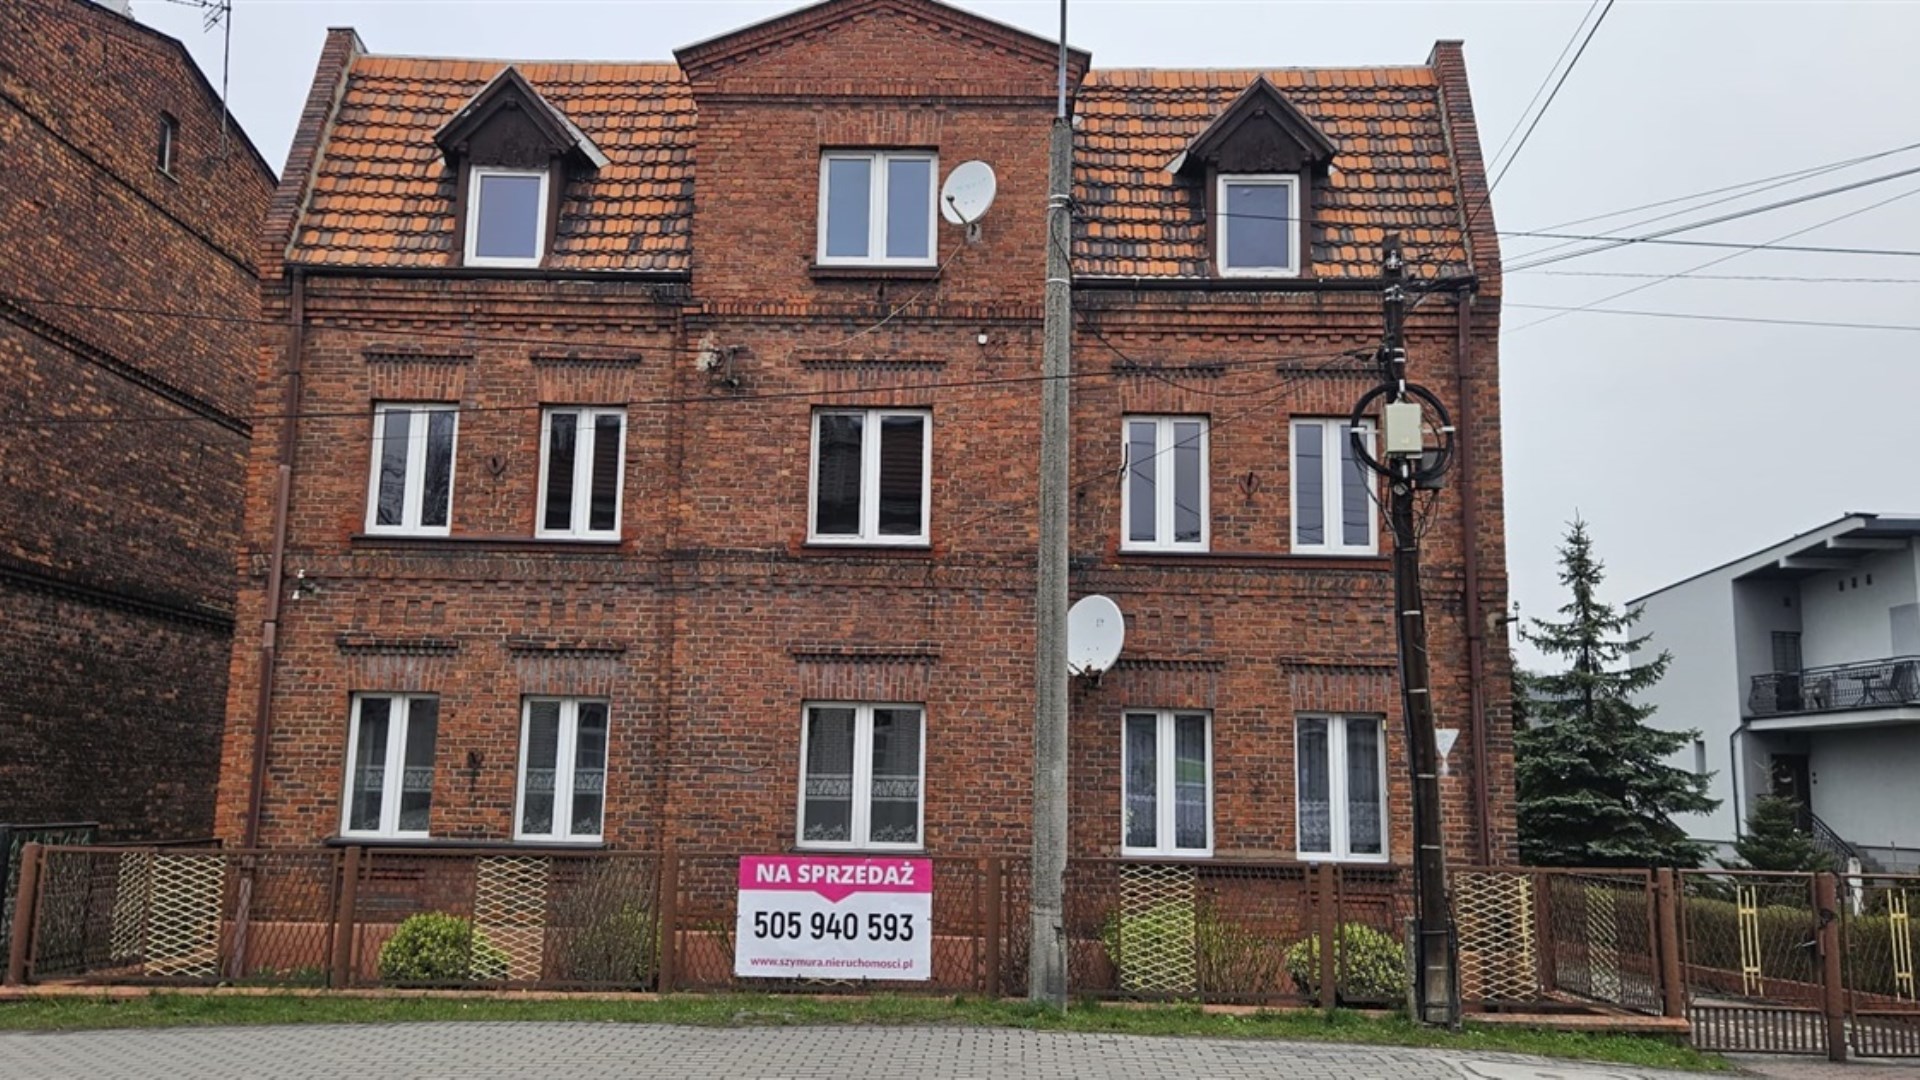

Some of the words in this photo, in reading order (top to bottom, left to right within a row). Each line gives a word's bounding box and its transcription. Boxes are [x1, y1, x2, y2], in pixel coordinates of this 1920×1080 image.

[756, 864, 791, 883] NA
[797, 862, 915, 885] SPRZEDAŻ
[754, 911, 801, 939] 505
[810, 912, 858, 940] 940
[867, 913, 914, 941] 593
[750, 956, 913, 970] www.szymura.nieruchomosci.pl
